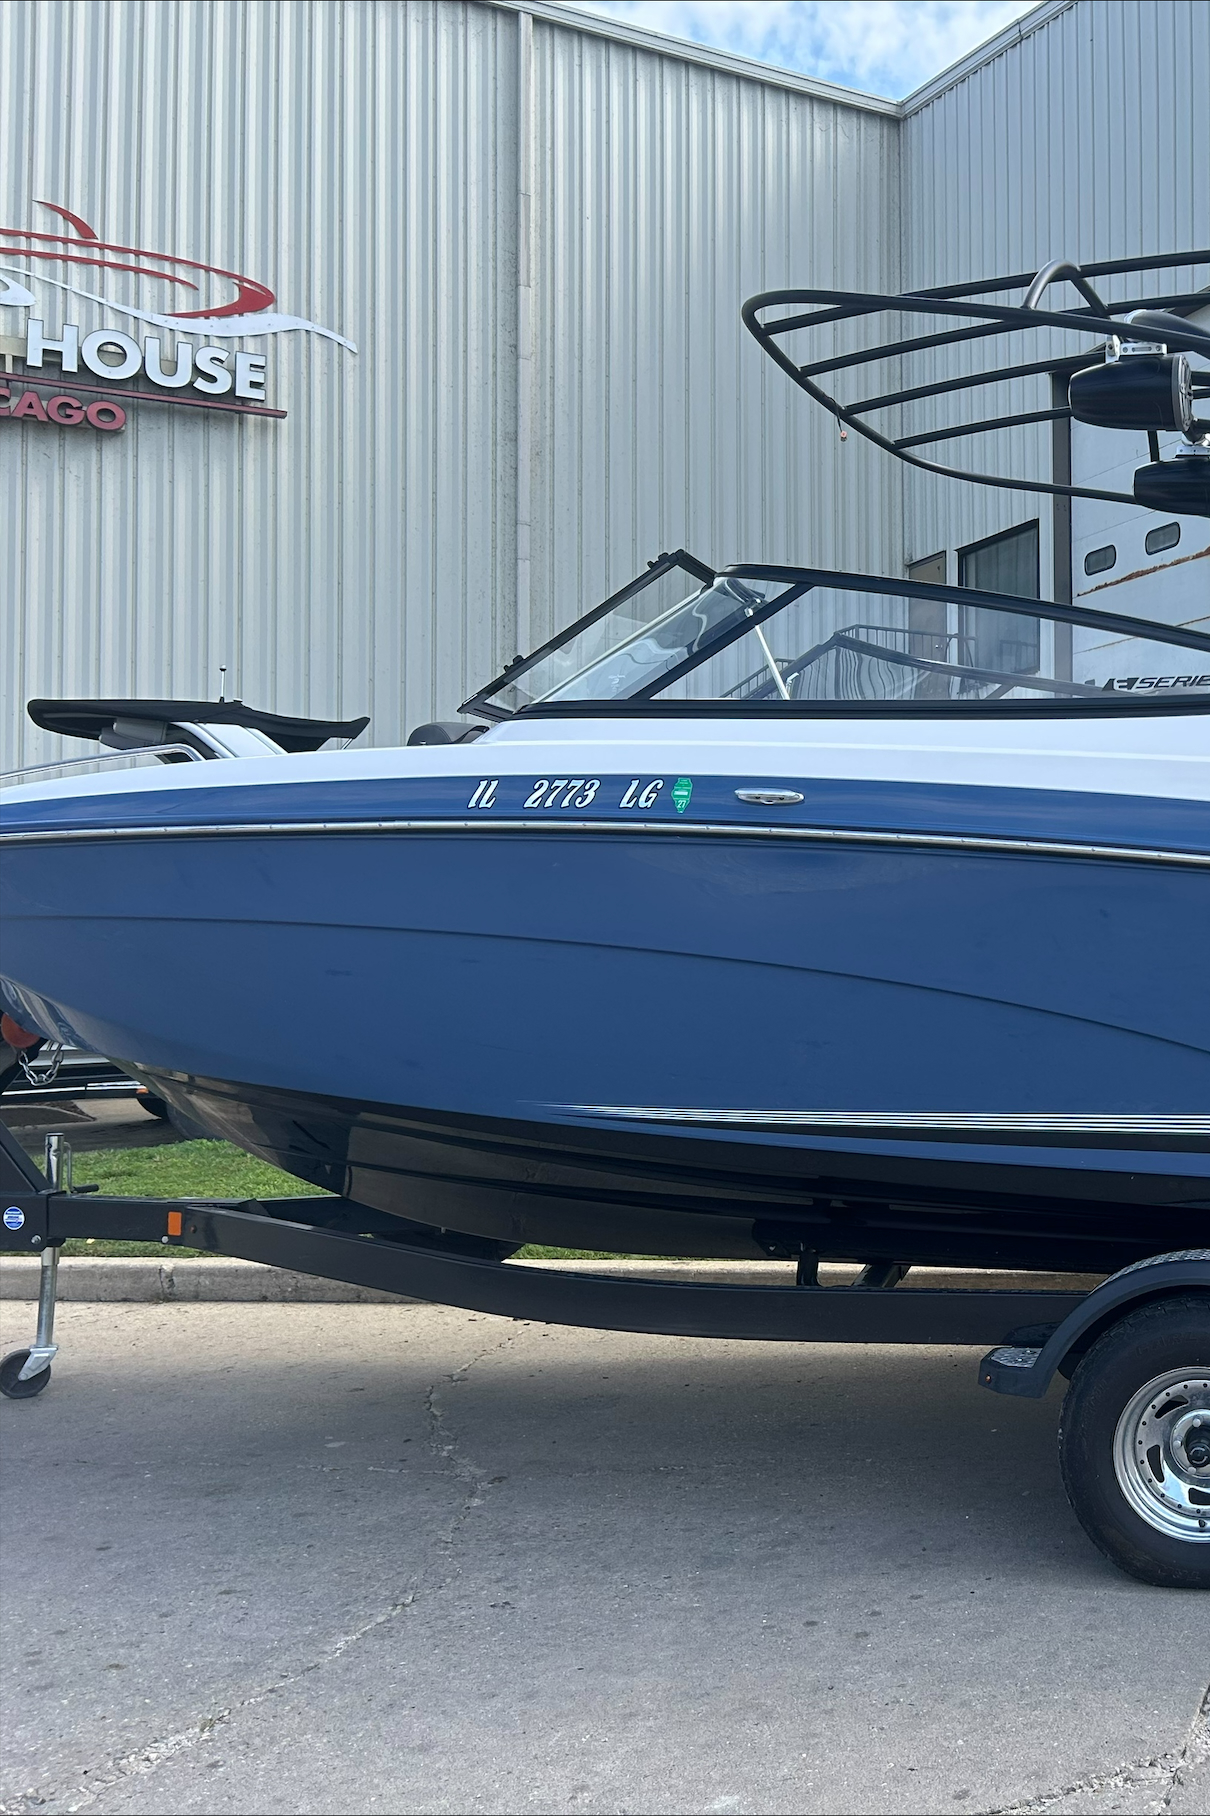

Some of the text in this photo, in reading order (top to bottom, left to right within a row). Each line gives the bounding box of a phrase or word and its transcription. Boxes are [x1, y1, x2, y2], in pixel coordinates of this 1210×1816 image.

[26, 318, 267, 401] HOUSE
[467, 779, 499, 809] IL
[523, 779, 601, 809] 2773
[619, 779, 664, 809] LG
